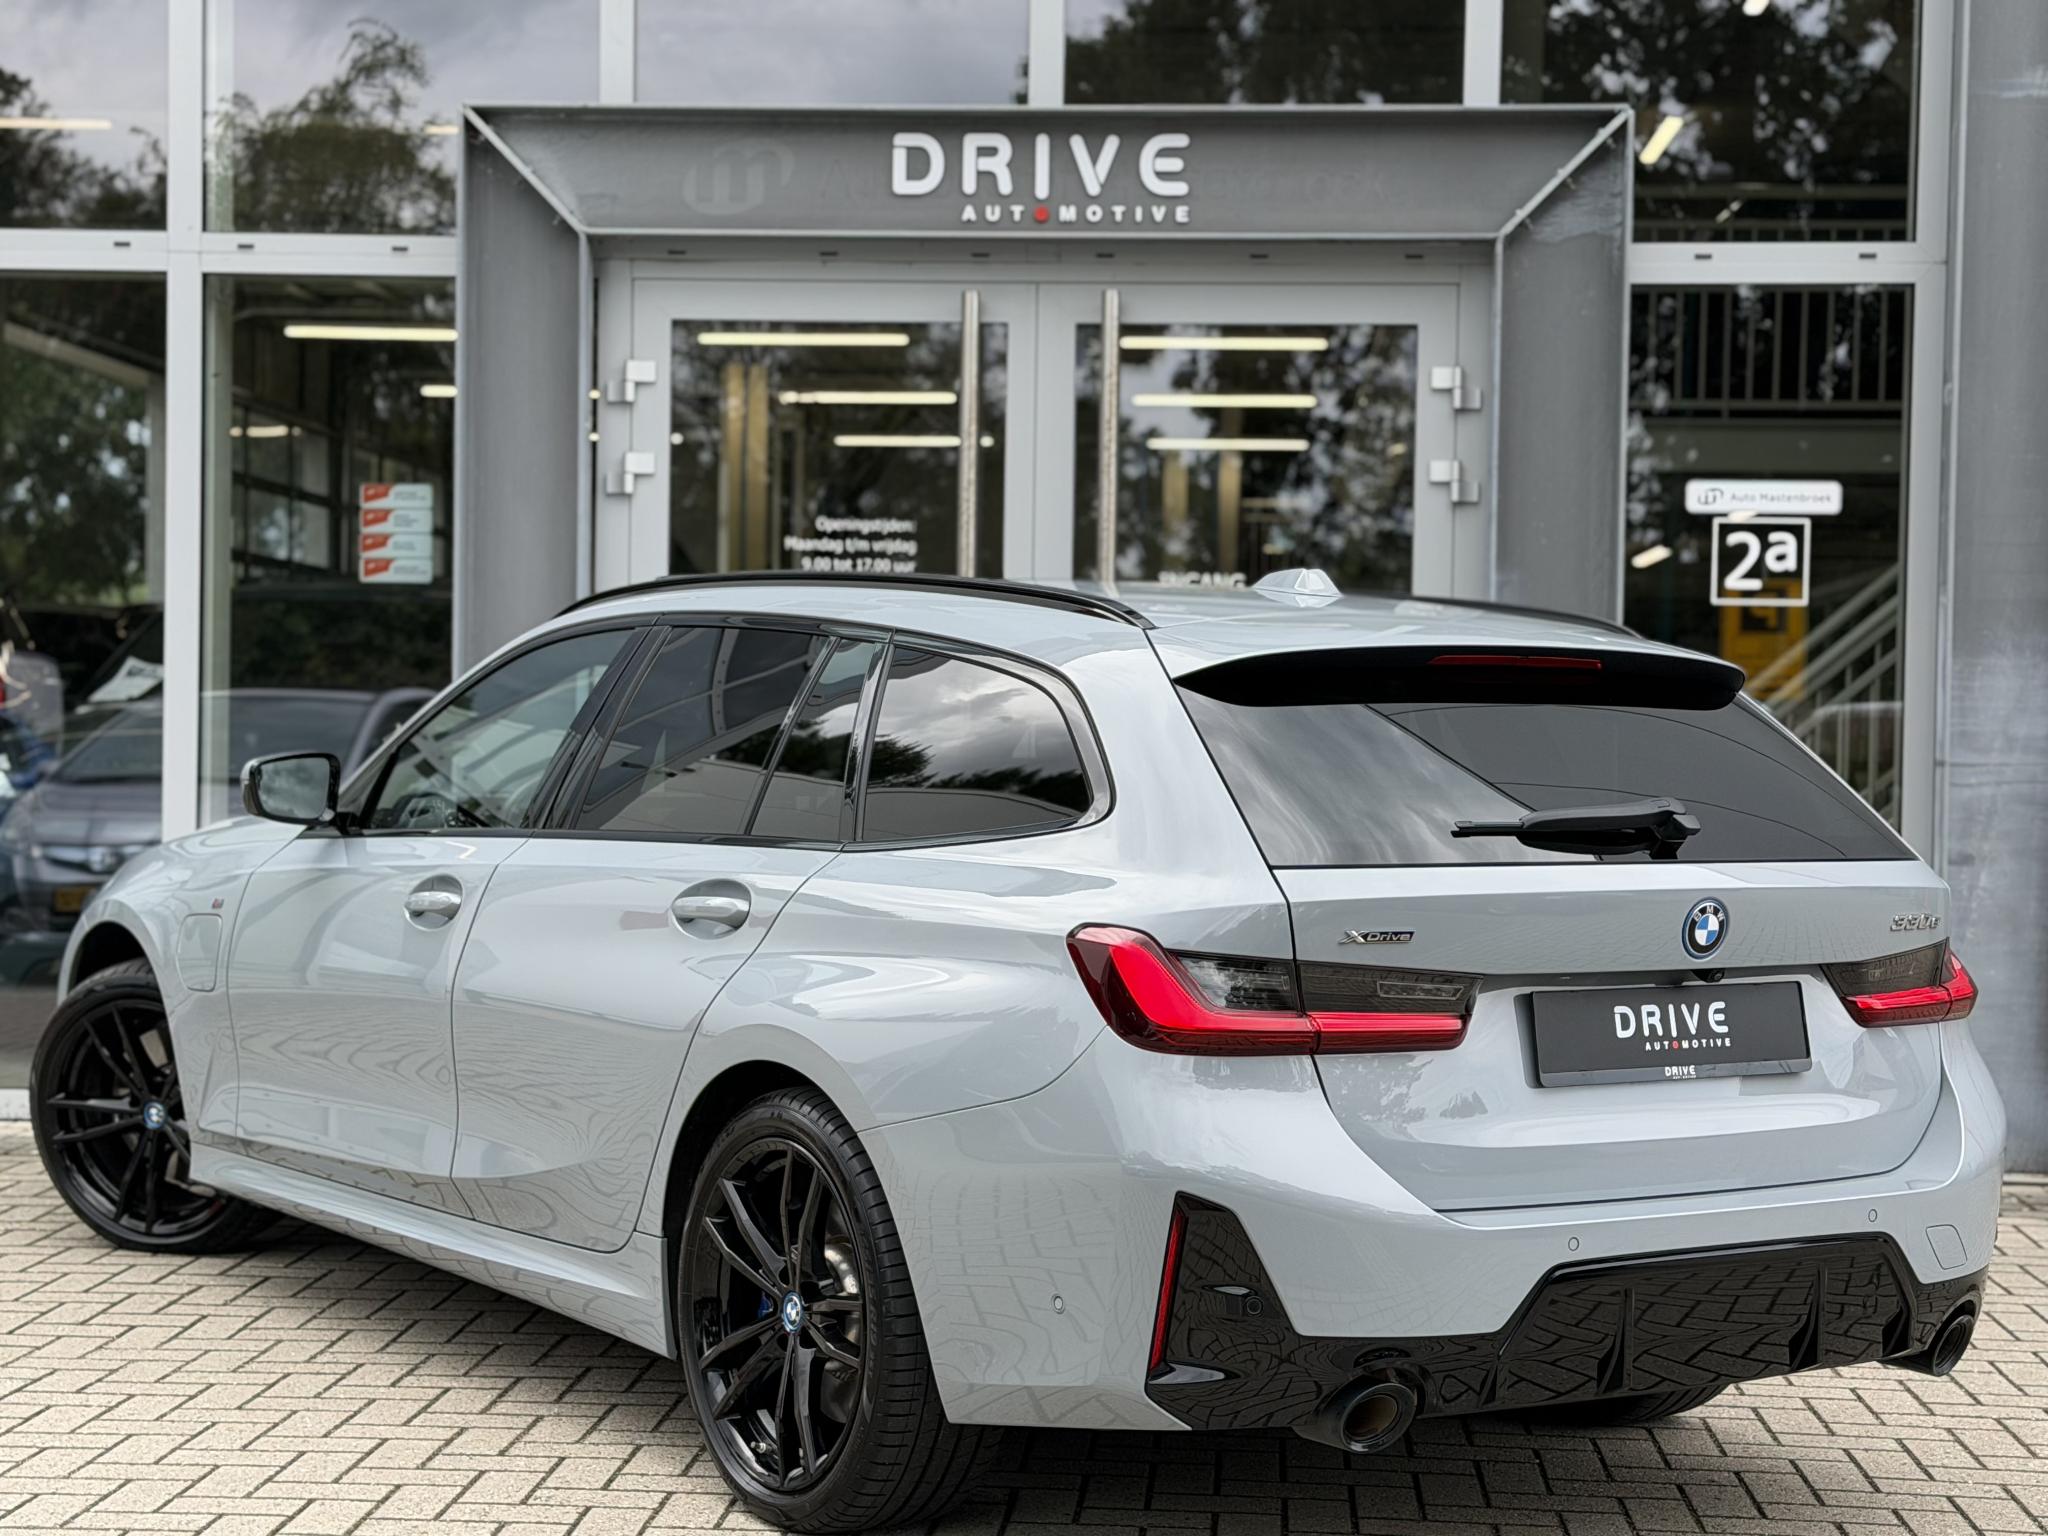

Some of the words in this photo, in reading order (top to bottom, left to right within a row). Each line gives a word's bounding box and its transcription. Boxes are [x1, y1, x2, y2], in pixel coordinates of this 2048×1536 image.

[891, 132, 1191, 199] DRIVE
[1730, 493, 1757, 503] Auto
[1723, 530, 1798, 591] 2a
[1613, 1001, 1729, 1038] DRIVE
[1645, 1037, 1732, 1051] AUTOMOTIVE
[1664, 1064, 1696, 1077] DRIVE
